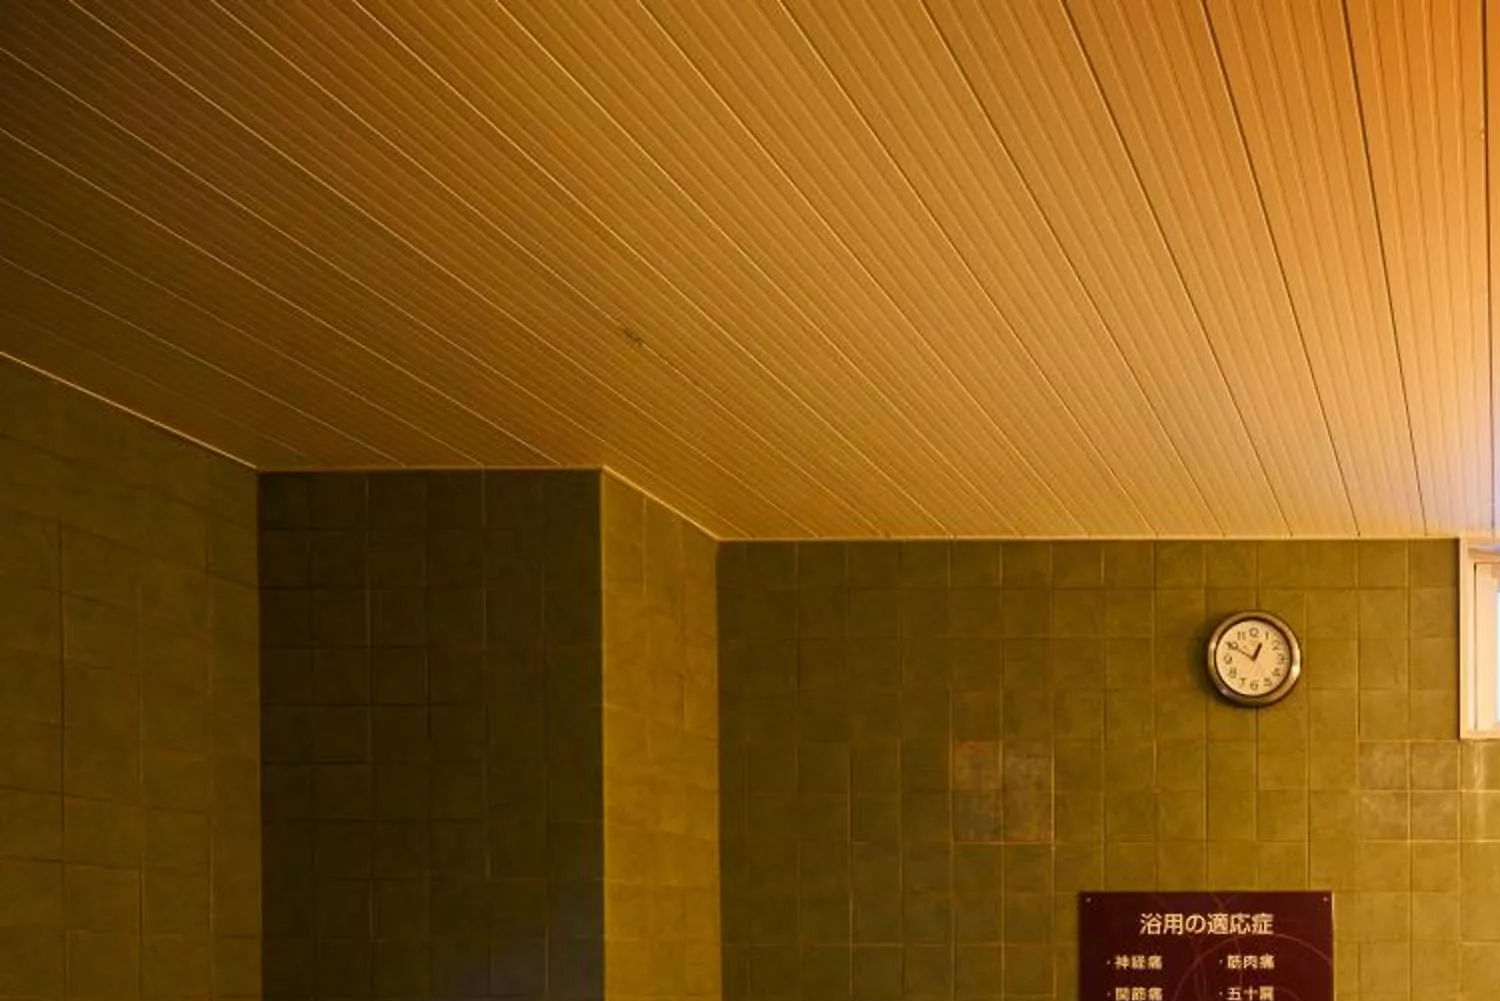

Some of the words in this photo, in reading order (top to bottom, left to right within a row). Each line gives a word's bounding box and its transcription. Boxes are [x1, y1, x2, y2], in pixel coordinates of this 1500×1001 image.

[1139, 912, 1274, 935] 浴用の適応症
[1114, 955, 1163, 969] 神経痛
[1226, 954, 1275, 969] 筋肉痛
[1115, 987, 1163, 1001] 関節痛
[1227, 986, 1275, 1001] 五十肩
